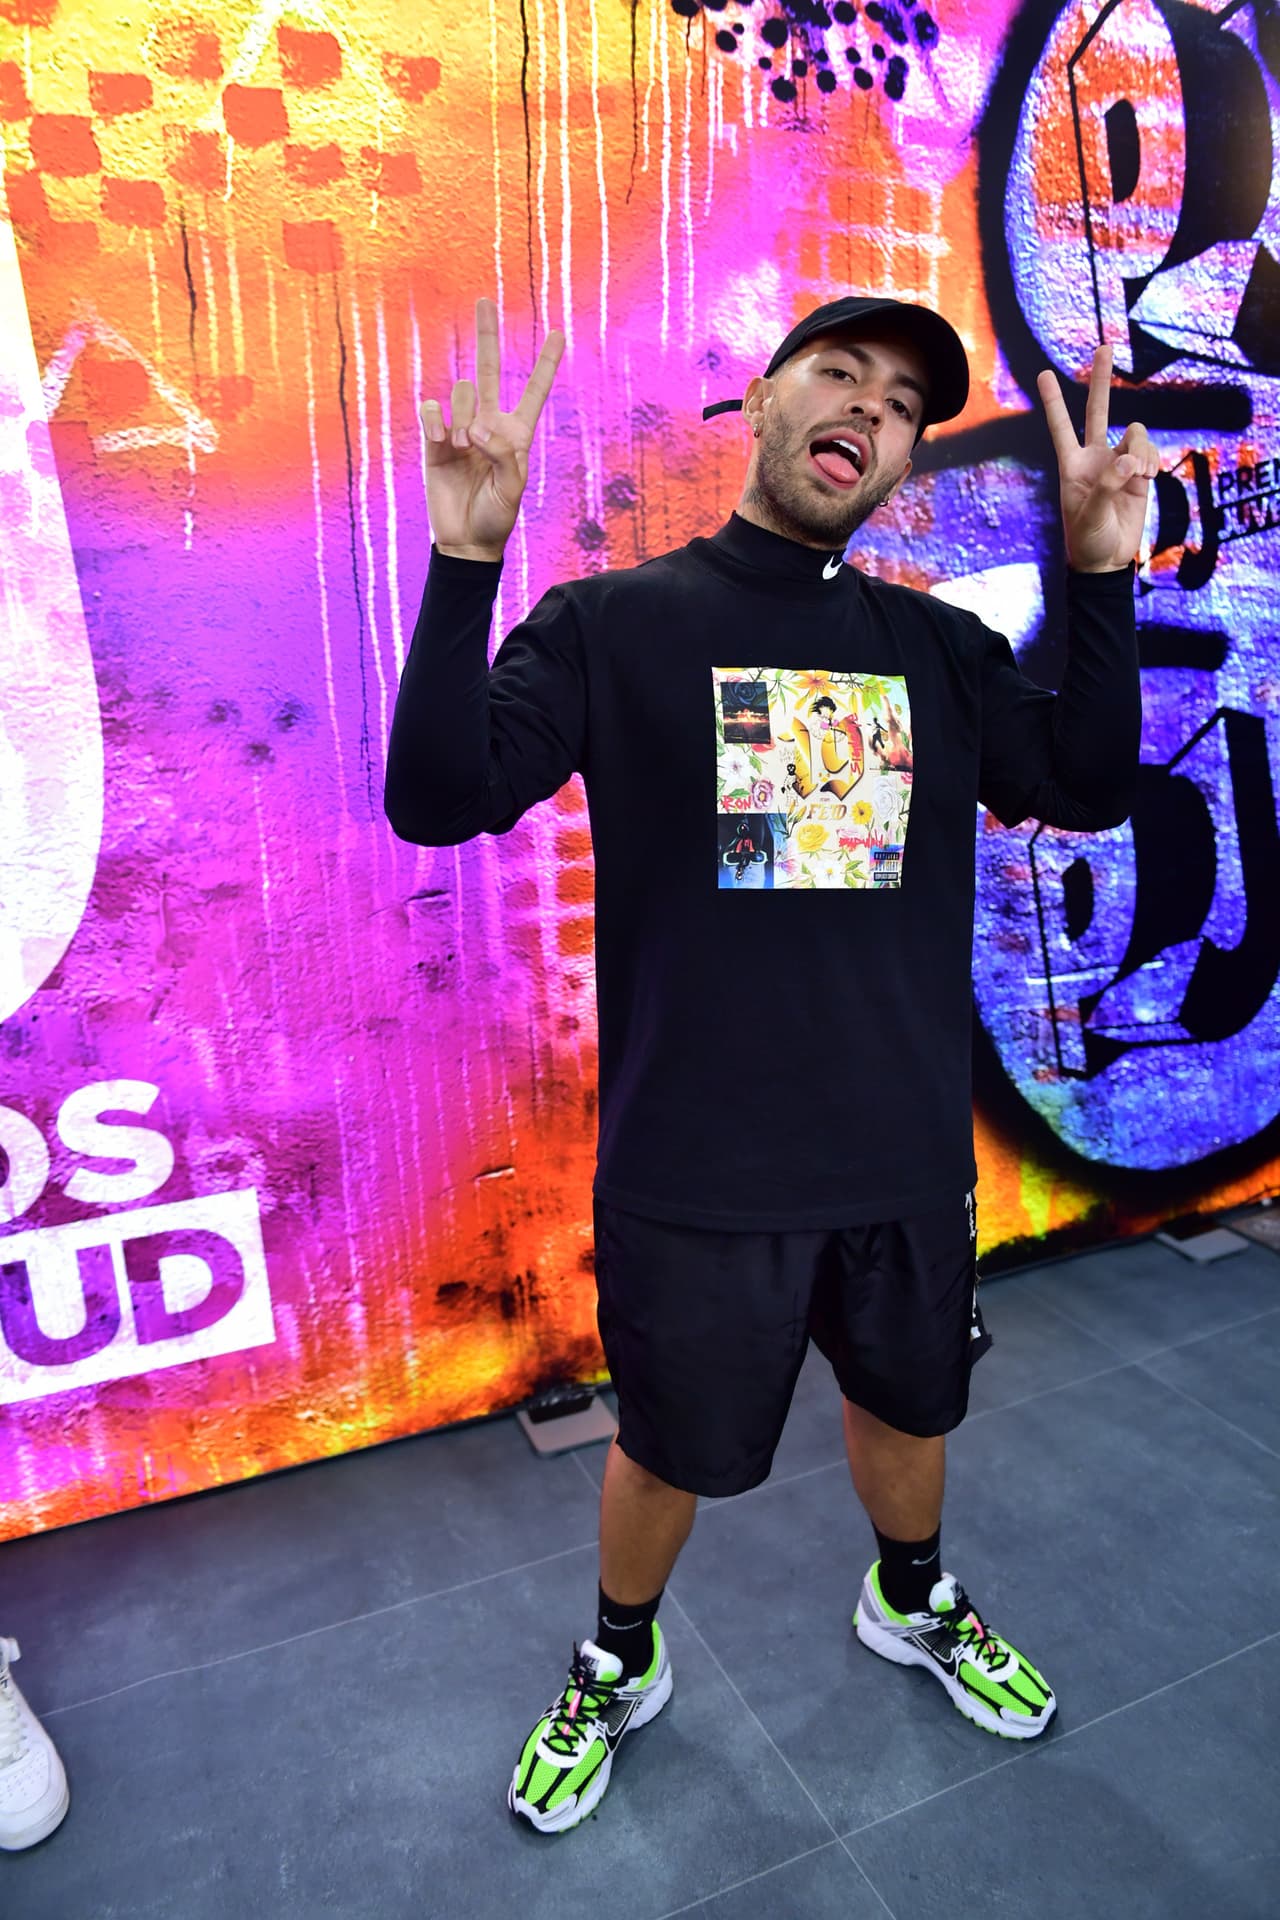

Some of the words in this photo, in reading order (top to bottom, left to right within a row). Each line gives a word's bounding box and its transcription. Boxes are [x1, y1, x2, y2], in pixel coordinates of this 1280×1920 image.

[1217, 458, 1280, 502] PRE
[720, 794, 752, 813] RON
[0, 1229, 244, 1366] UD
